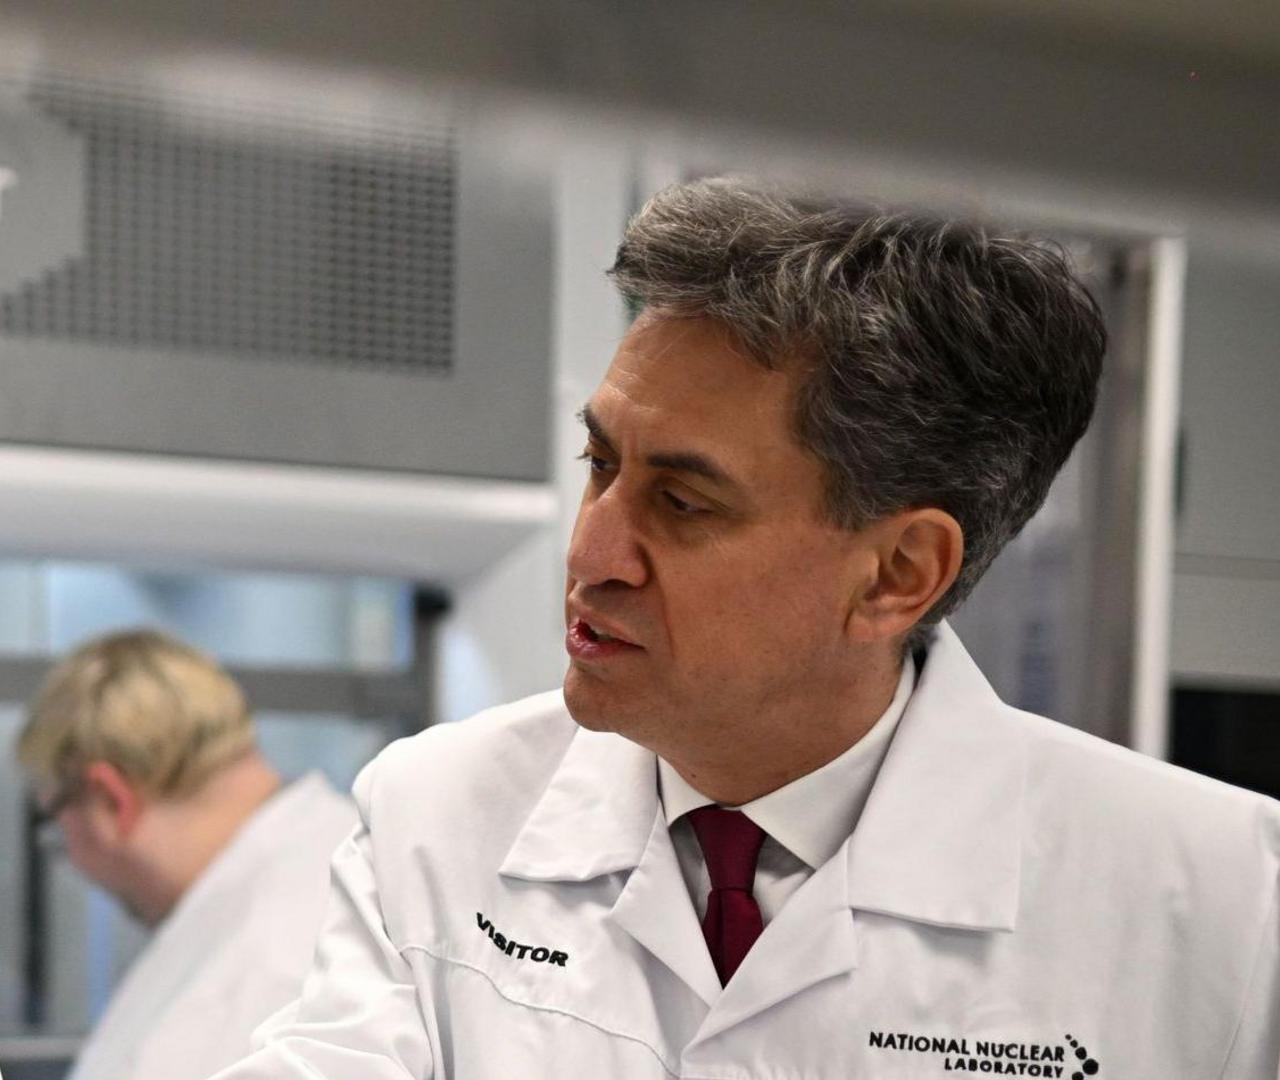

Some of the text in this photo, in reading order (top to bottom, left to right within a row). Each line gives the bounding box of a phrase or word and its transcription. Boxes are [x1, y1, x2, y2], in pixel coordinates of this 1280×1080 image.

[476, 911, 569, 967] VISITOR
[868, 1031, 1066, 1063] NATIONAL NUCLEAR
[943, 1057, 1065, 1079] LABORATORY
